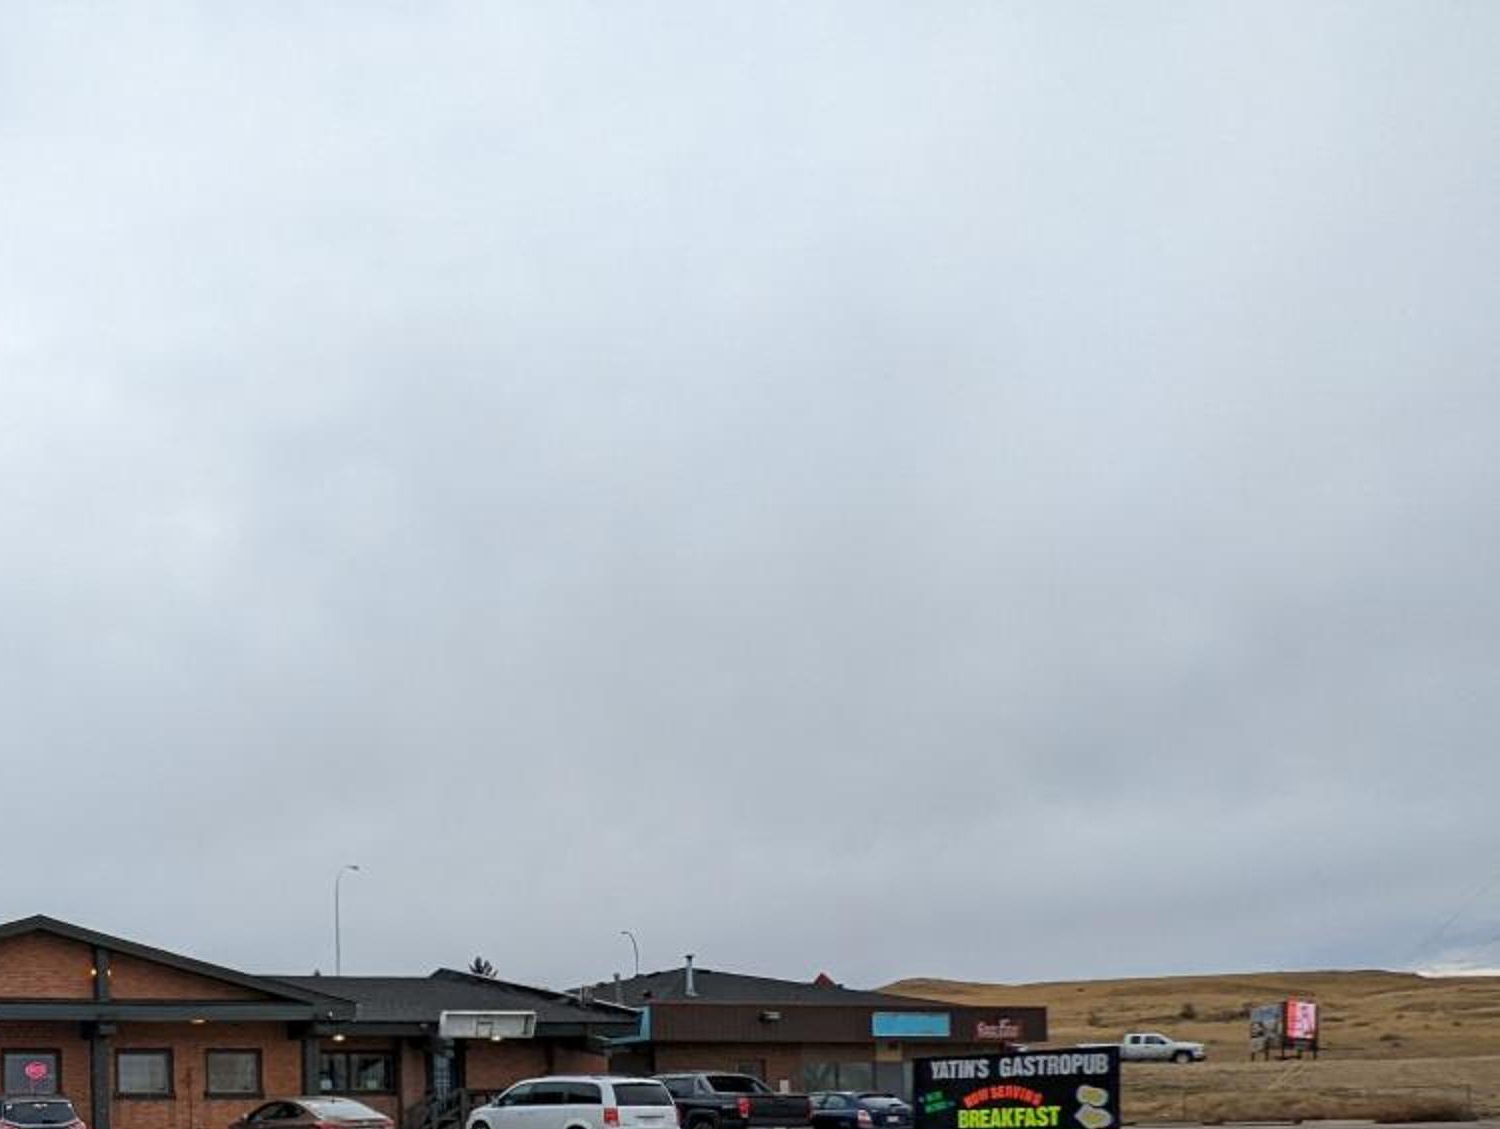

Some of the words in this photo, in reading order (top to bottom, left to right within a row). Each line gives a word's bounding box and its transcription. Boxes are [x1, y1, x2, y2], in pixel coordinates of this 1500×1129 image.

[931, 1059, 989, 1079] YATIN'S
[999, 1053, 1109, 1078] GASTROPUB
[957, 1106, 1061, 1129] BREAKFAST
